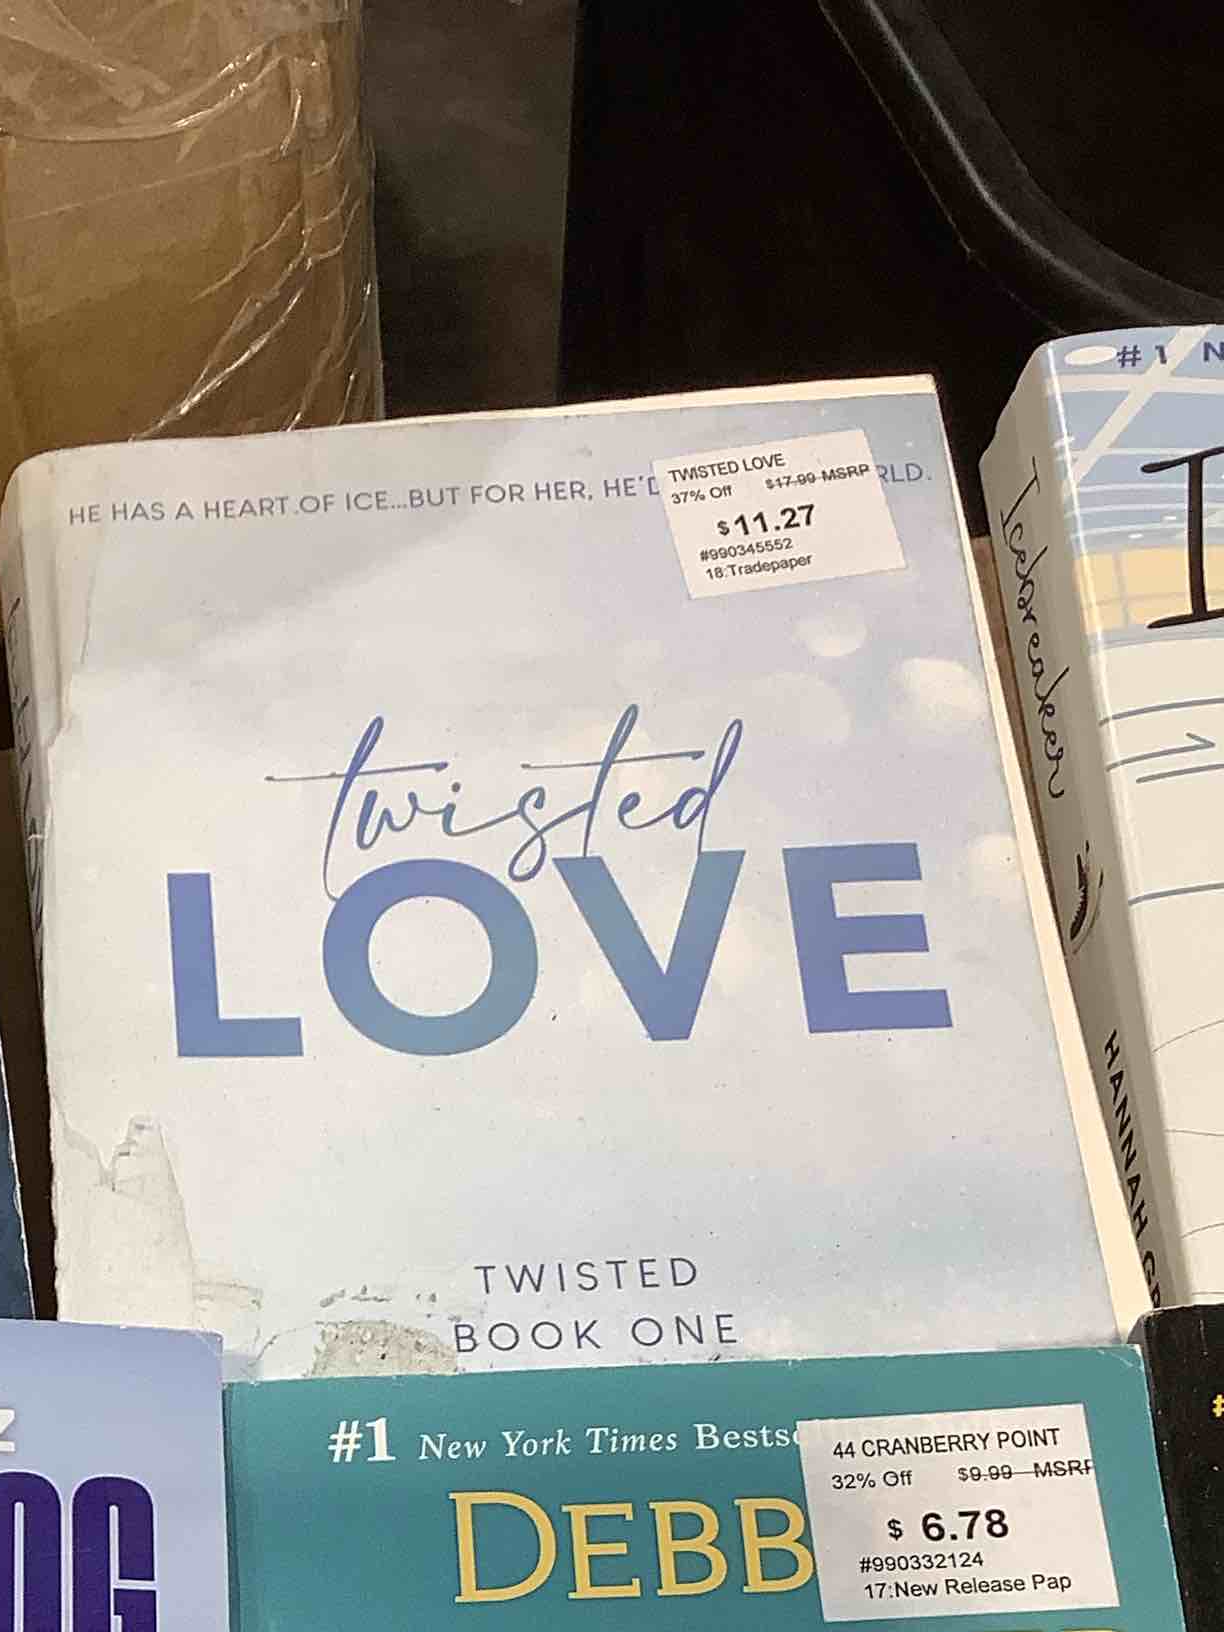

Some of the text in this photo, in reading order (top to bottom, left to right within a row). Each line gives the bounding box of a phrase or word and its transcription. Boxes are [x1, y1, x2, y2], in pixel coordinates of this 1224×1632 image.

[668, 453, 786, 483] TWISTED LOVE
[671, 463, 870, 505] 37% Off $17.99 MSRP
[68, 504, 101, 525] HE
[112, 502, 165, 521] HAS
[175, 502, 195, 520] A
[204, 496, 288, 519] HEART
[299, 494, 335, 514] OF
[471, 484, 525, 505] FOR
[534, 481, 593, 501] HER,
[876, 463, 932, 483] RLD.
[700, 538, 793, 562] #990345552
[999, 456, 1070, 798] Icebreaker
[265, 703, 744, 903] twisted
[166, 842, 954, 1058] LOVE
[1103, 1028, 1149, 1241] HANNAH
[474, 1257, 698, 1294] TWISTED
[454, 1314, 738, 1354] BOOK ONE
[328, 1417, 396, 1463] #1
[417, 1433, 488, 1461] New
[501, 1428, 573, 1458] York
[586, 1425, 679, 1455] Times
[832, 1428, 1060, 1459] 44 CRANBERRY POINT
[832, 1472, 876, 1490] 32%
[882, 1470, 913, 1487] Off
[957, 1464, 1013, 1482] $9.99
[887, 1508, 1009, 1542] $ 6.78
[448, 1489, 815, 1605] DEBB
[859, 1551, 984, 1573] #990332124
[863, 1573, 1072, 1600] 17:New Release Pap
